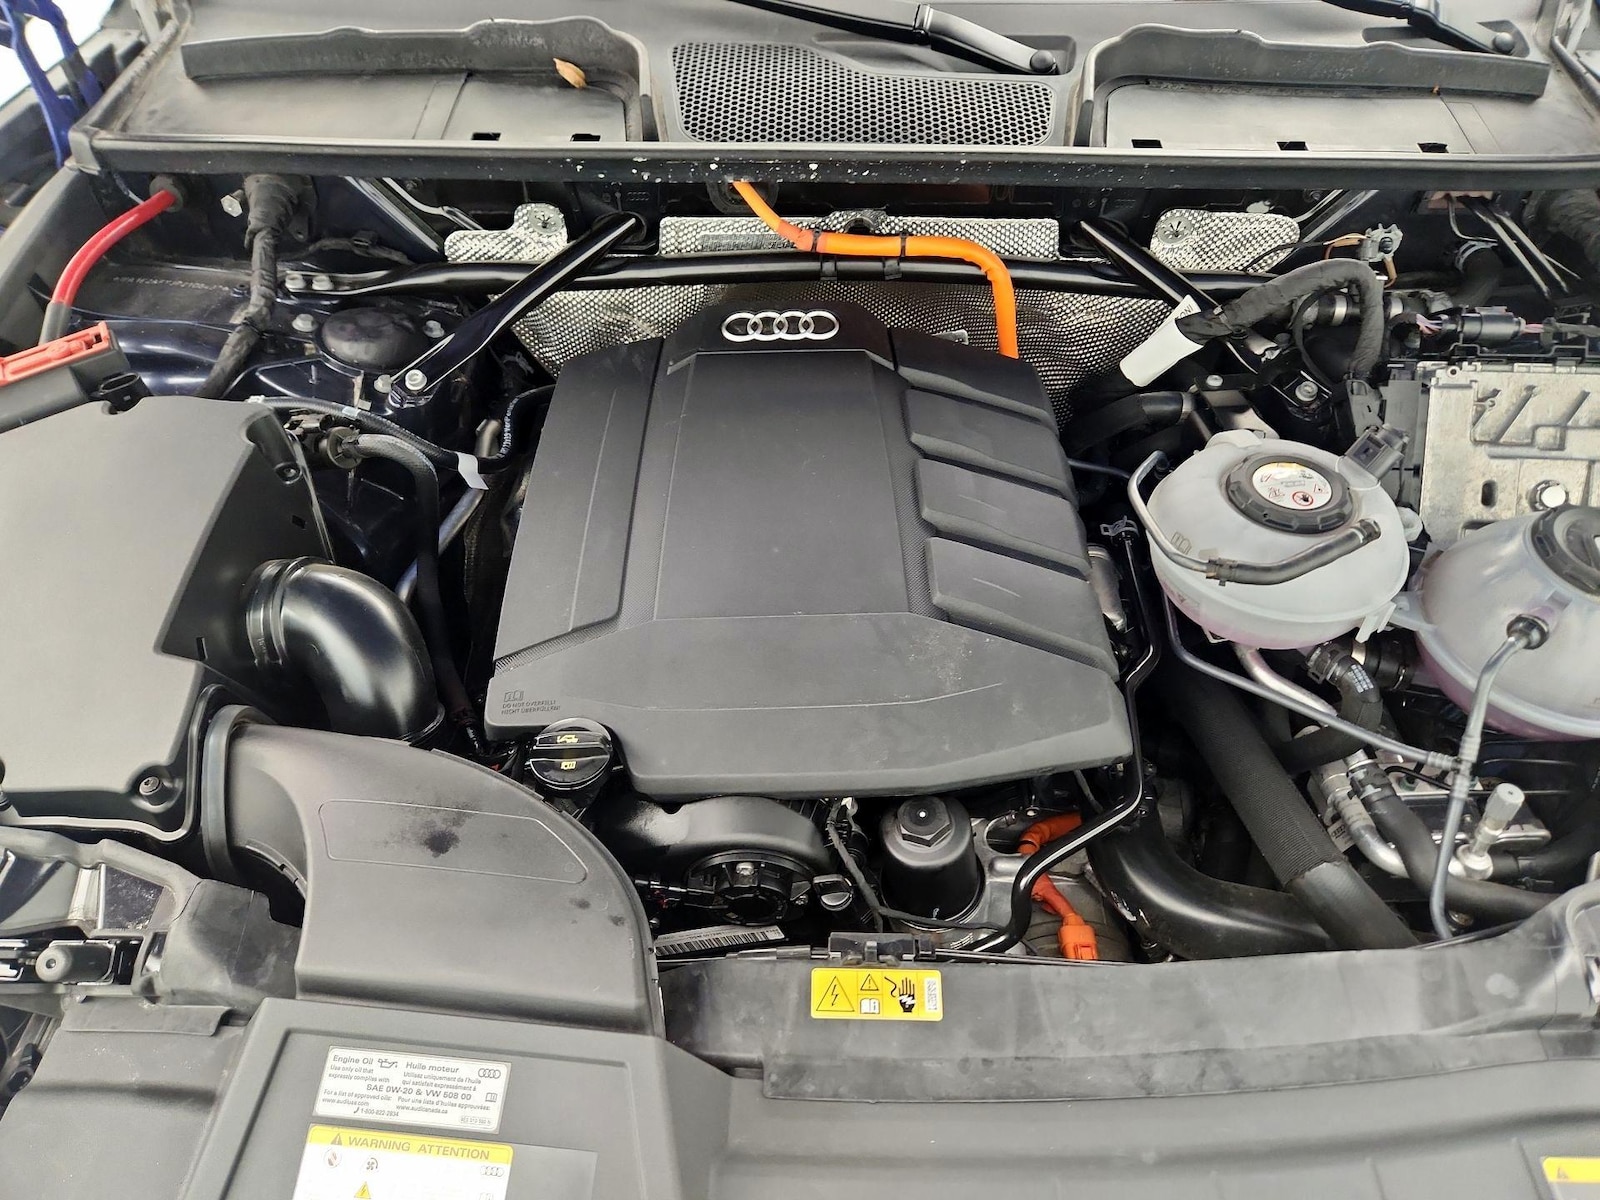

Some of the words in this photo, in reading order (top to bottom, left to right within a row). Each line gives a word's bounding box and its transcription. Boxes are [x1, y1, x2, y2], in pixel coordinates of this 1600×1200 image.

[333, 1054, 360, 1064] Engine
[362, 1057, 374, 1065] Oil
[342, 1065, 354, 1073] only
[406, 1061, 427, 1071] Huile
[428, 1065, 459, 1073] moteur
[328, 1072, 353, 1080] expressly
[424, 1074, 456, 1083] uniquement
[412, 1080, 434, 1088] satisfait
[366, 1083, 384, 1092] SAE
[385, 1085, 413, 1095] 0W-20
[416, 1088, 422, 1096] &
[425, 1089, 442, 1097] VW
[443, 1091, 459, 1099] 508
[354, 1092, 379, 1100] approved
[423, 1098, 435, 1106] liste
[348, 1135, 411, 1152] WARNING
[417, 1144, 490, 1160] ATTENTION
